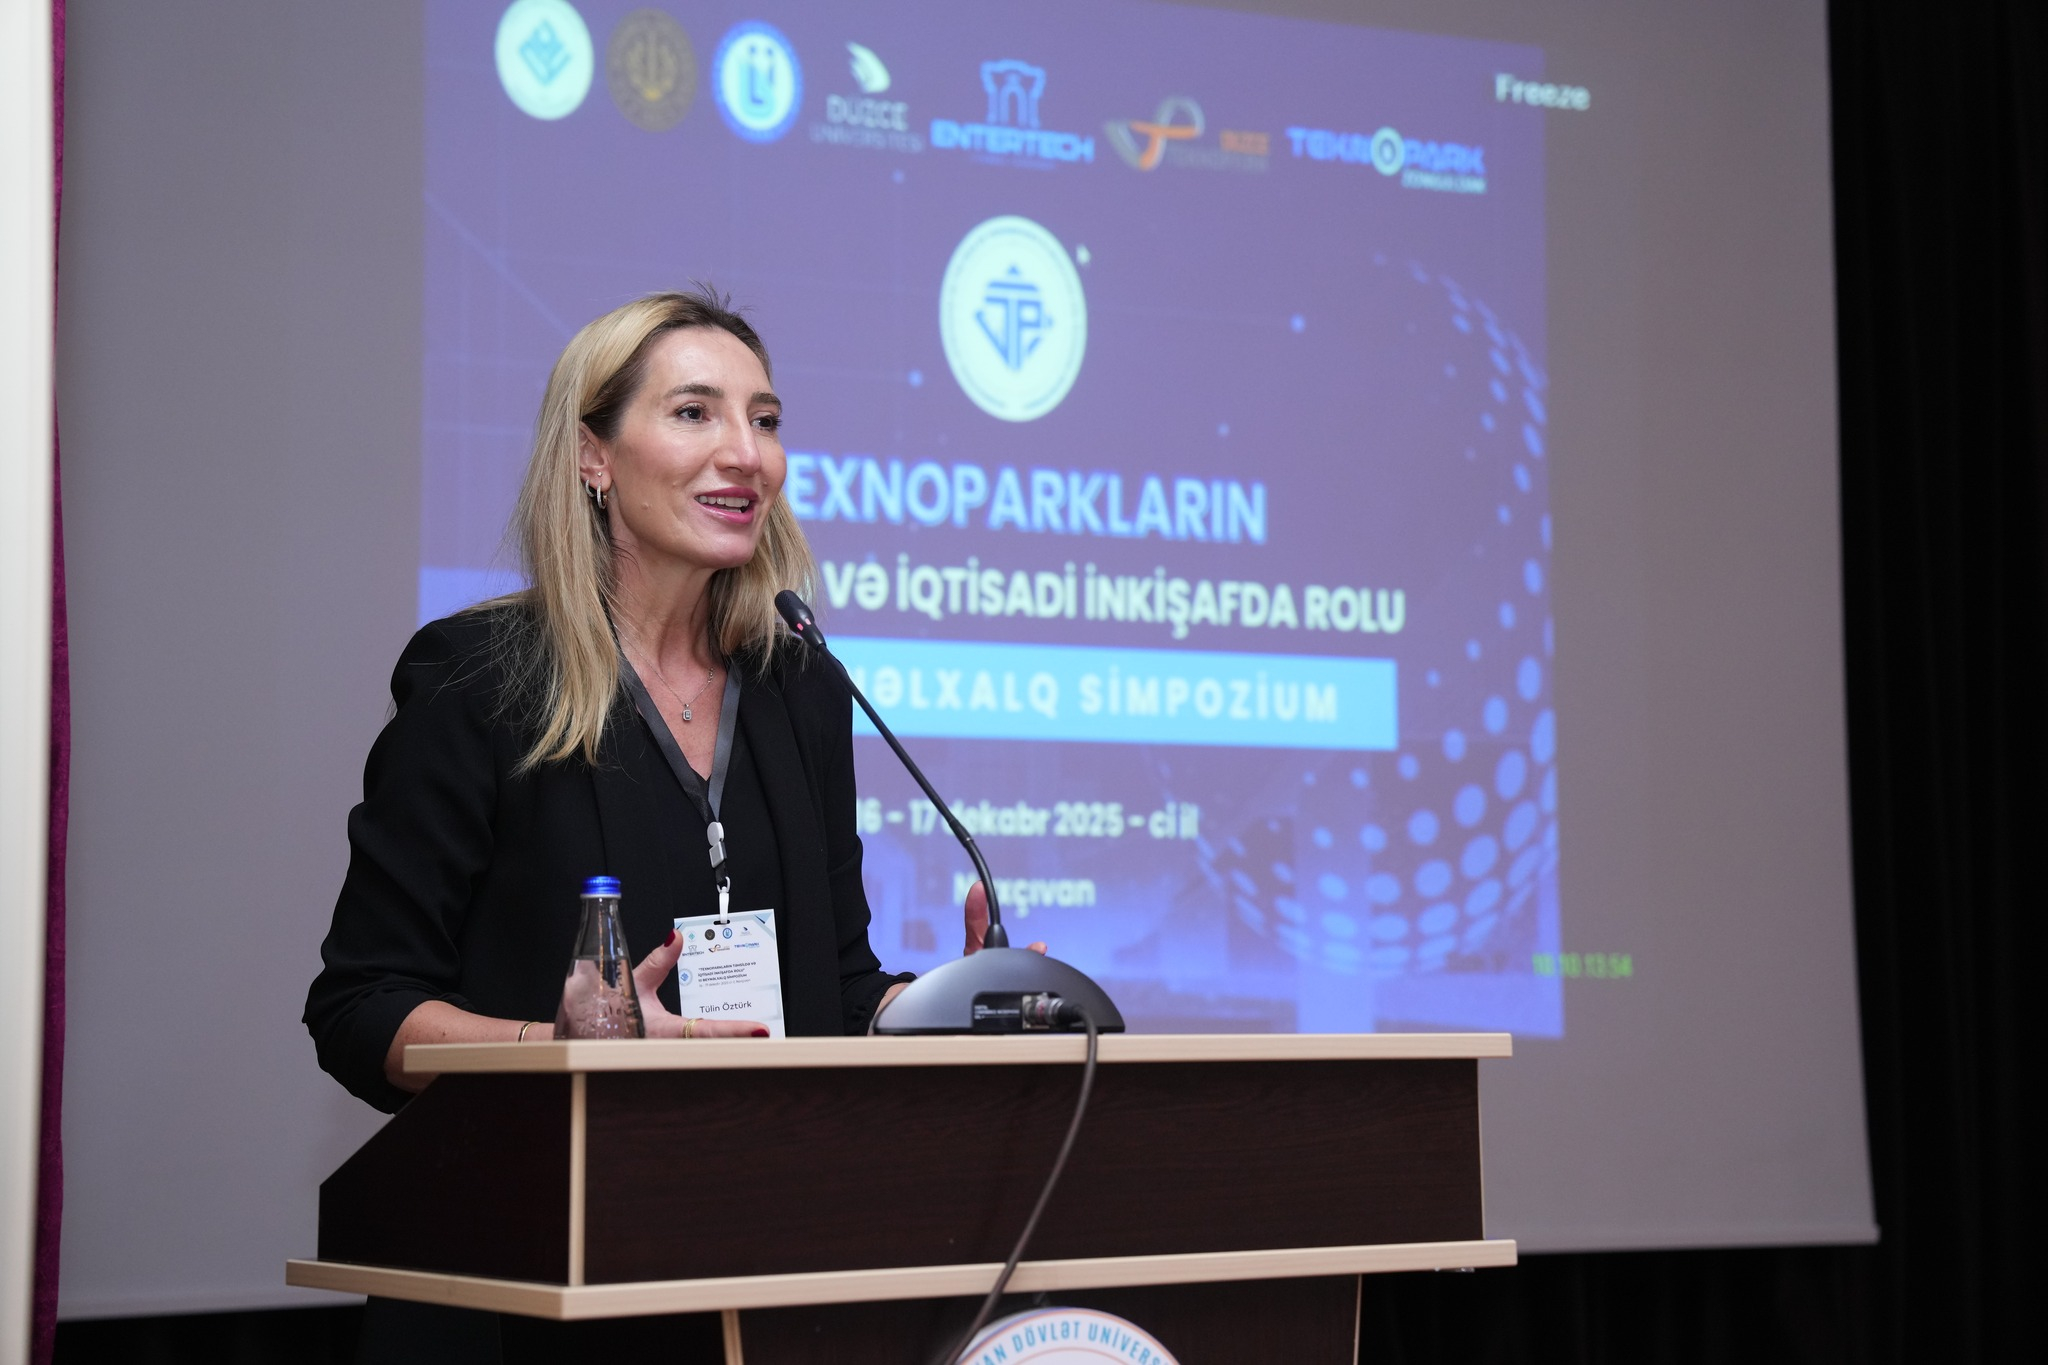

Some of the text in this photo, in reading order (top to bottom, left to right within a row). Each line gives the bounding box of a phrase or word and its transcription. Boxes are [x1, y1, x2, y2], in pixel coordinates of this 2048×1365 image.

[1495, 72, 1591, 111] Freeze
[930, 118, 1095, 163] ENTERTECH
[1287, 126, 1485, 175] TEKNOPARK
[786, 453, 1266, 544] EXNOPARKLARIN
[822, 552, 1406, 640] VƏ İQTİSADİ İNKİŞAFDA ROLU
[1079, 664, 1339, 723] SİMPOZİUM
[909, 799, 938, 835] 17
[1053, 800, 1125, 838] 2025
[699, 1000, 752, 1014] Tülin Öztürk
[1012, 1320, 1081, 1353] DÖVLƏT
